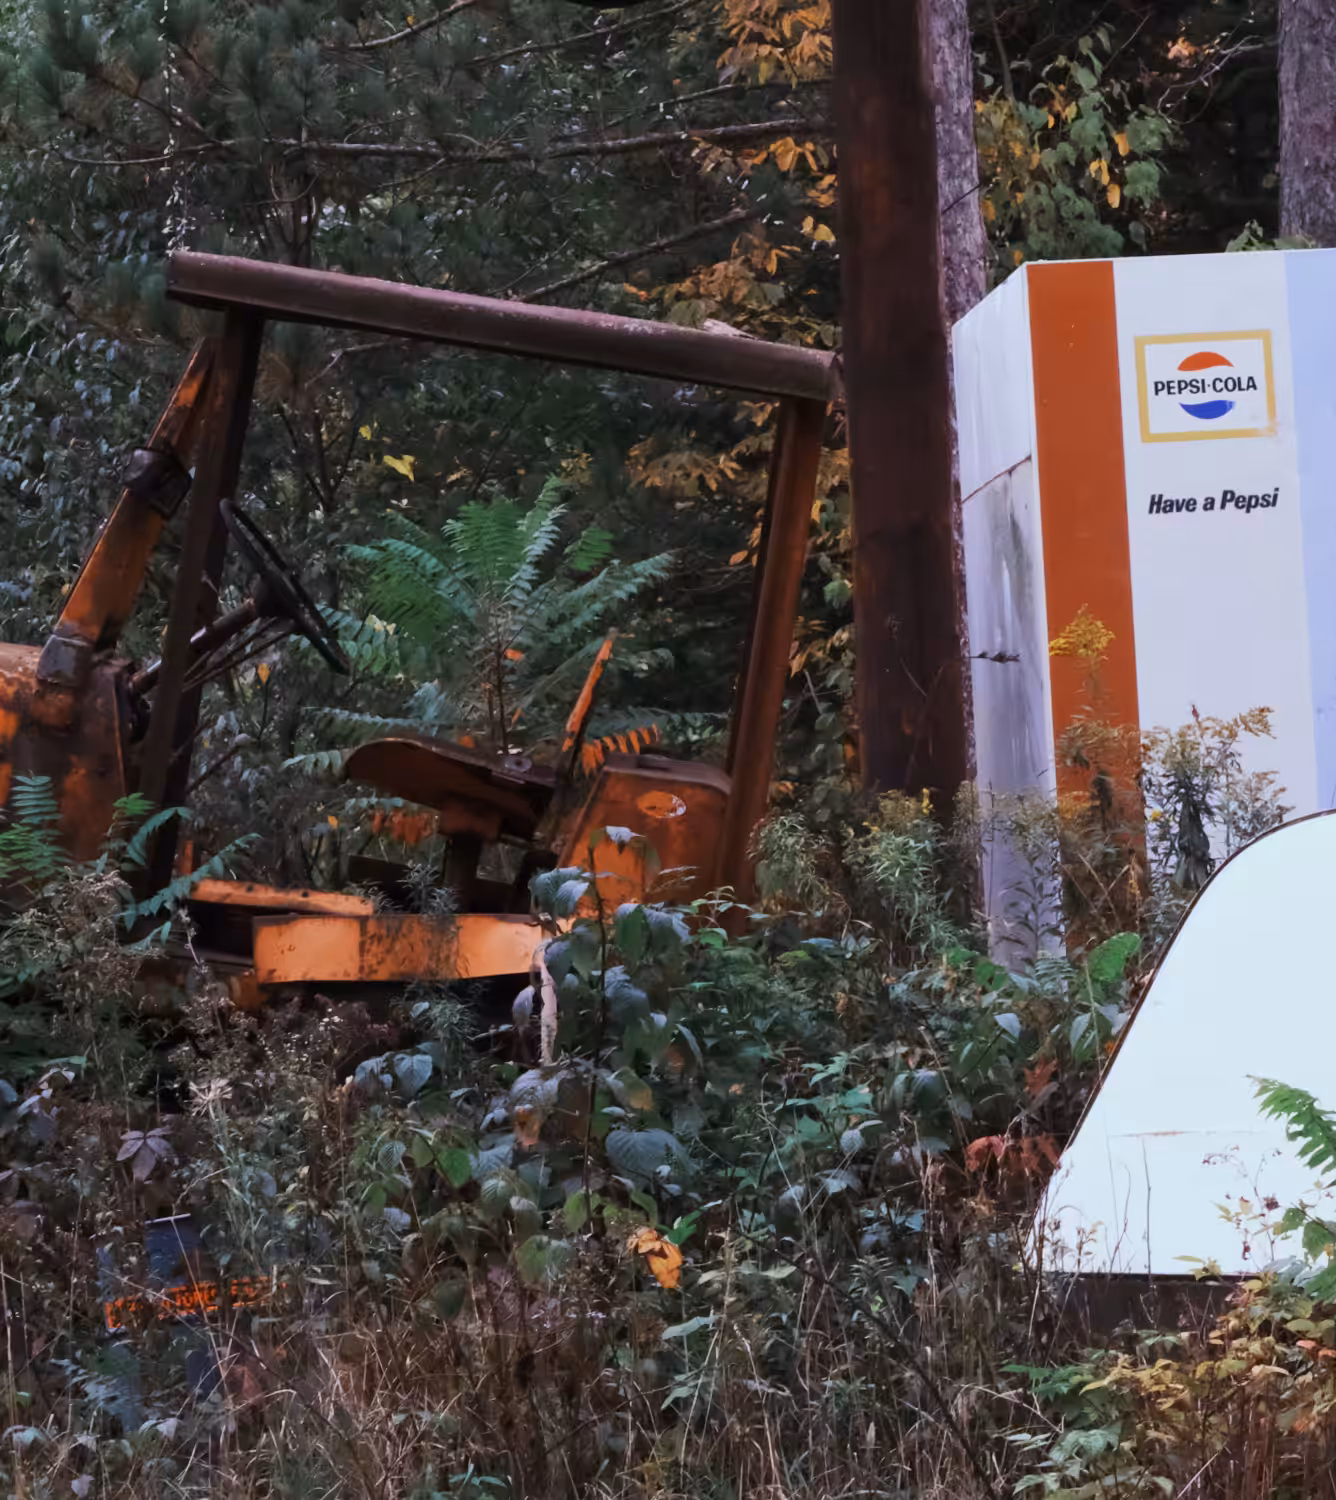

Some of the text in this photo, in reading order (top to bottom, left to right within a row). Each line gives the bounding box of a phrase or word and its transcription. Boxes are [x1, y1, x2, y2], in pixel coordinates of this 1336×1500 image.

[1148, 487, 1280, 515] Have a Pepsi
